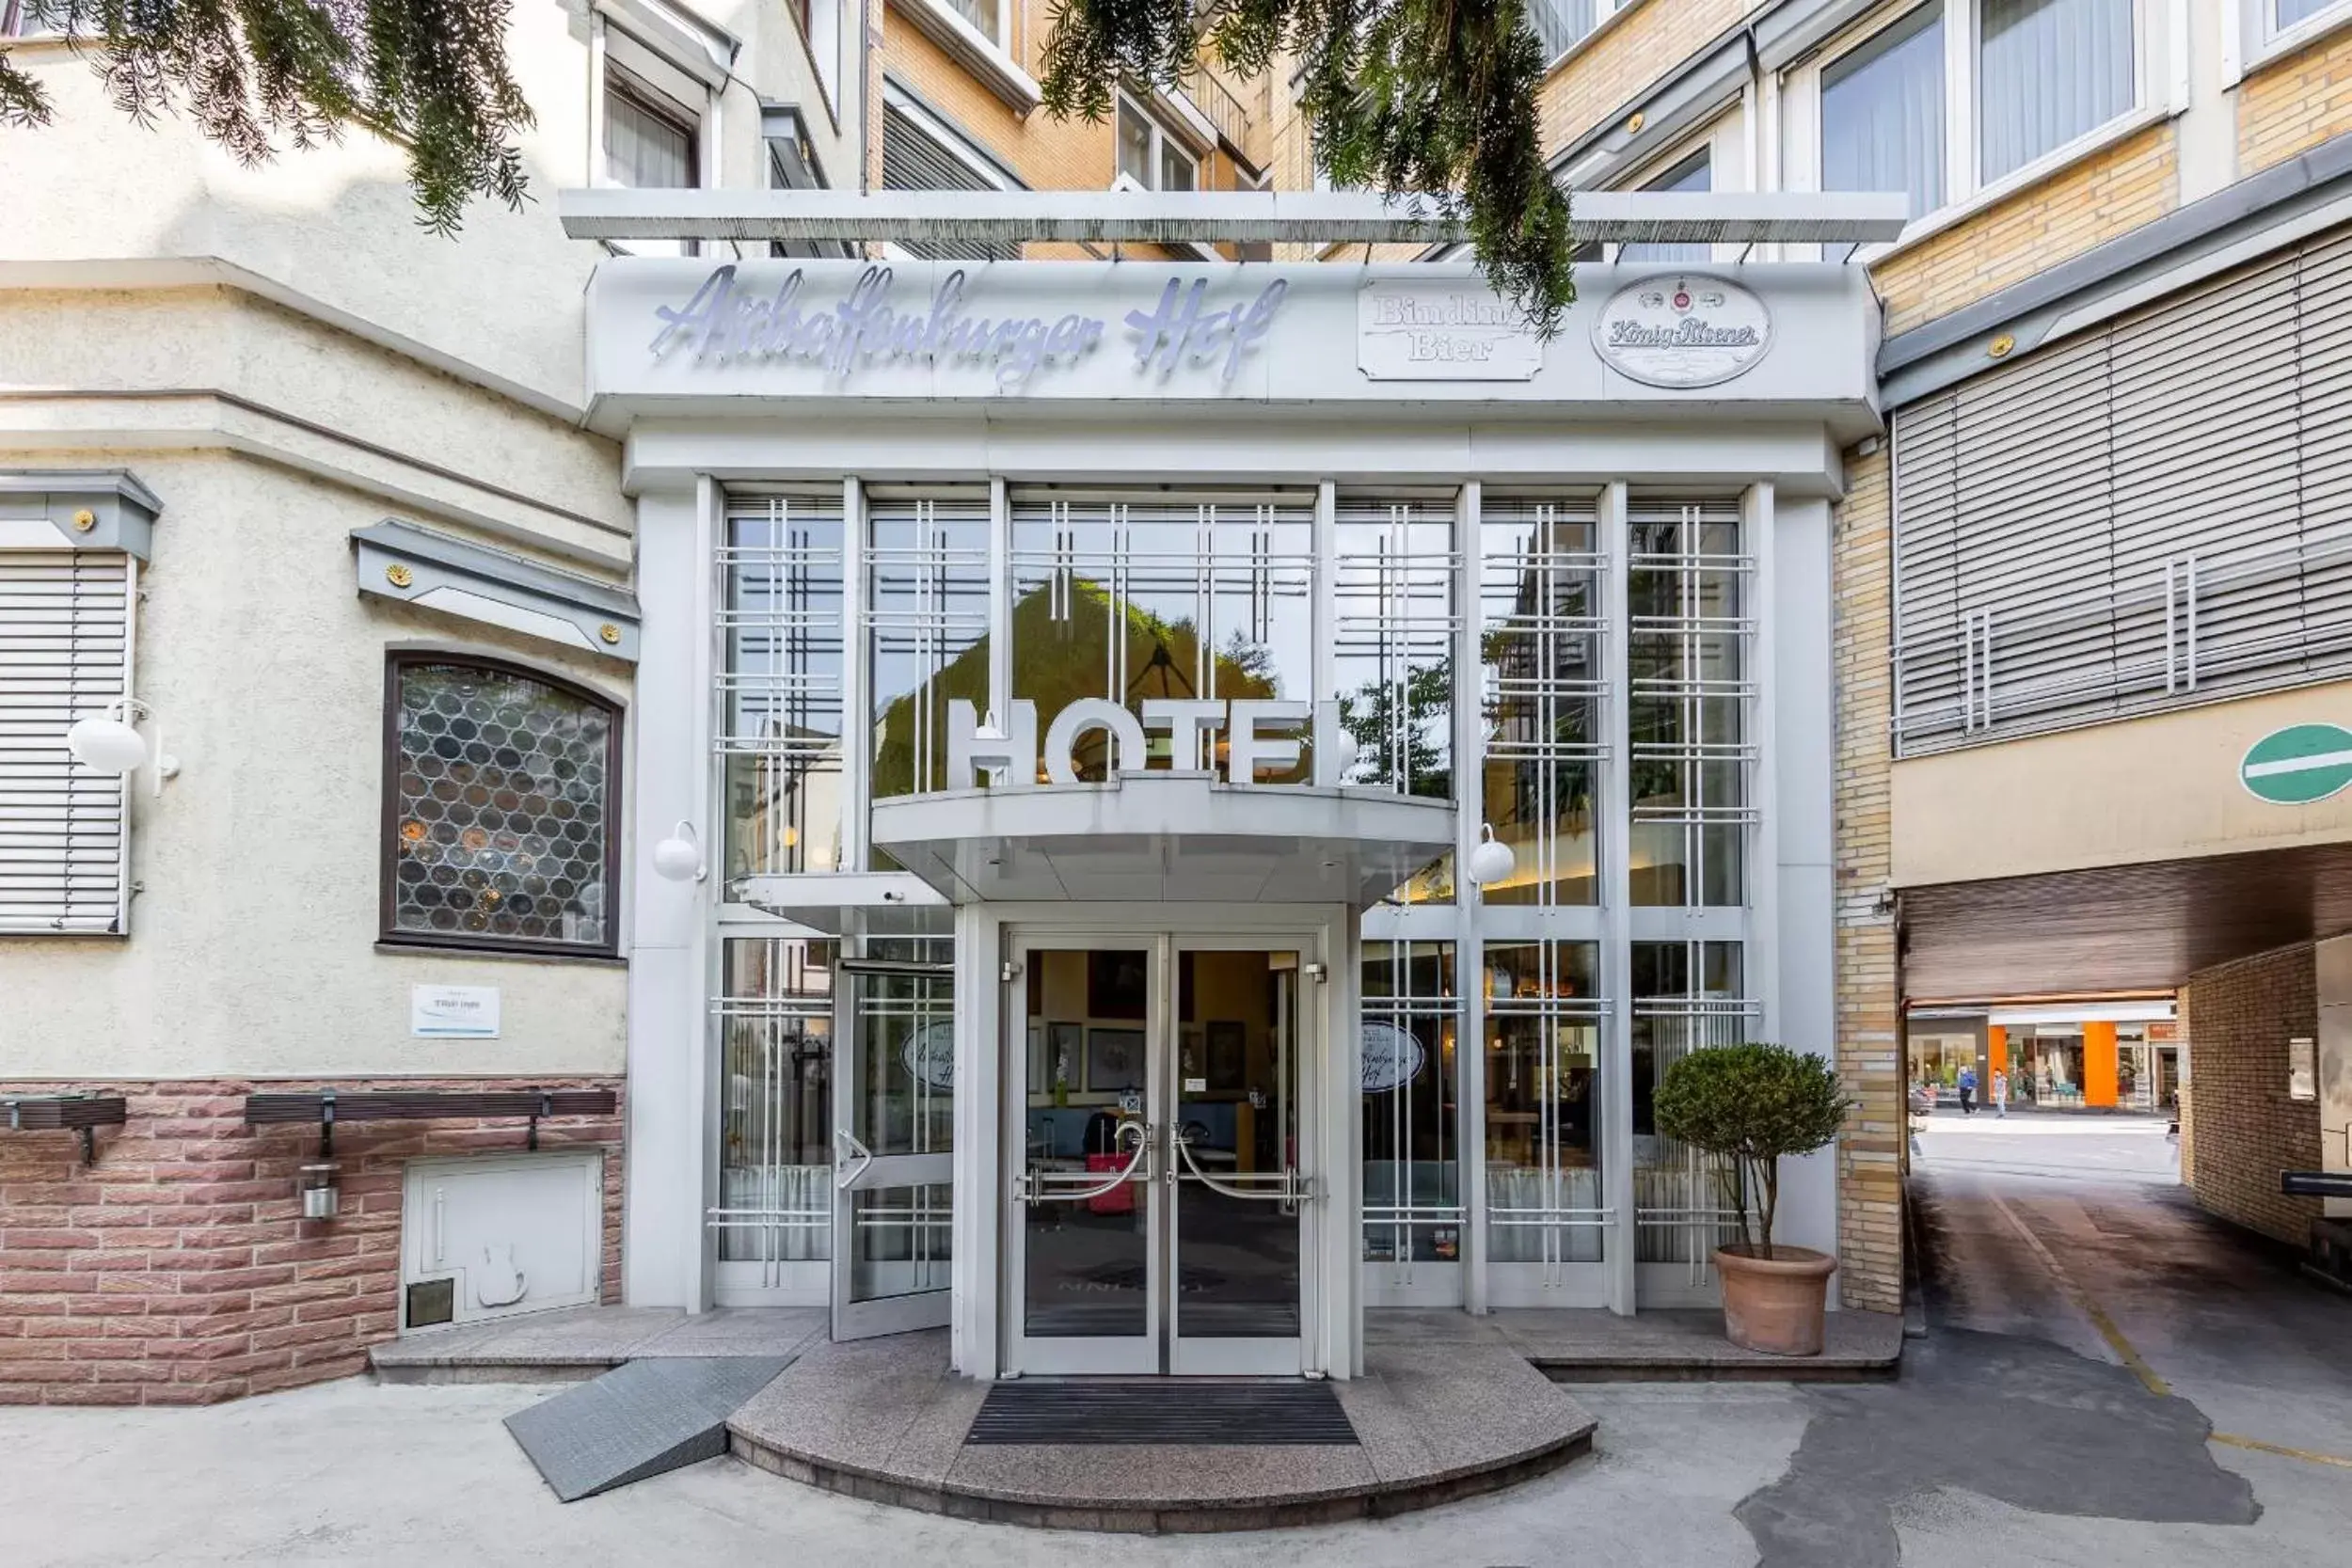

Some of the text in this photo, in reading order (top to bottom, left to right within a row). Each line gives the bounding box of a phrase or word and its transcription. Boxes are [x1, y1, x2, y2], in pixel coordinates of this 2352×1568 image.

[649, 264, 1288, 384] Aschaffenburger Hof
[1408, 332, 1494, 362] Bier
[946, 697, 1342, 790] HOTEL
